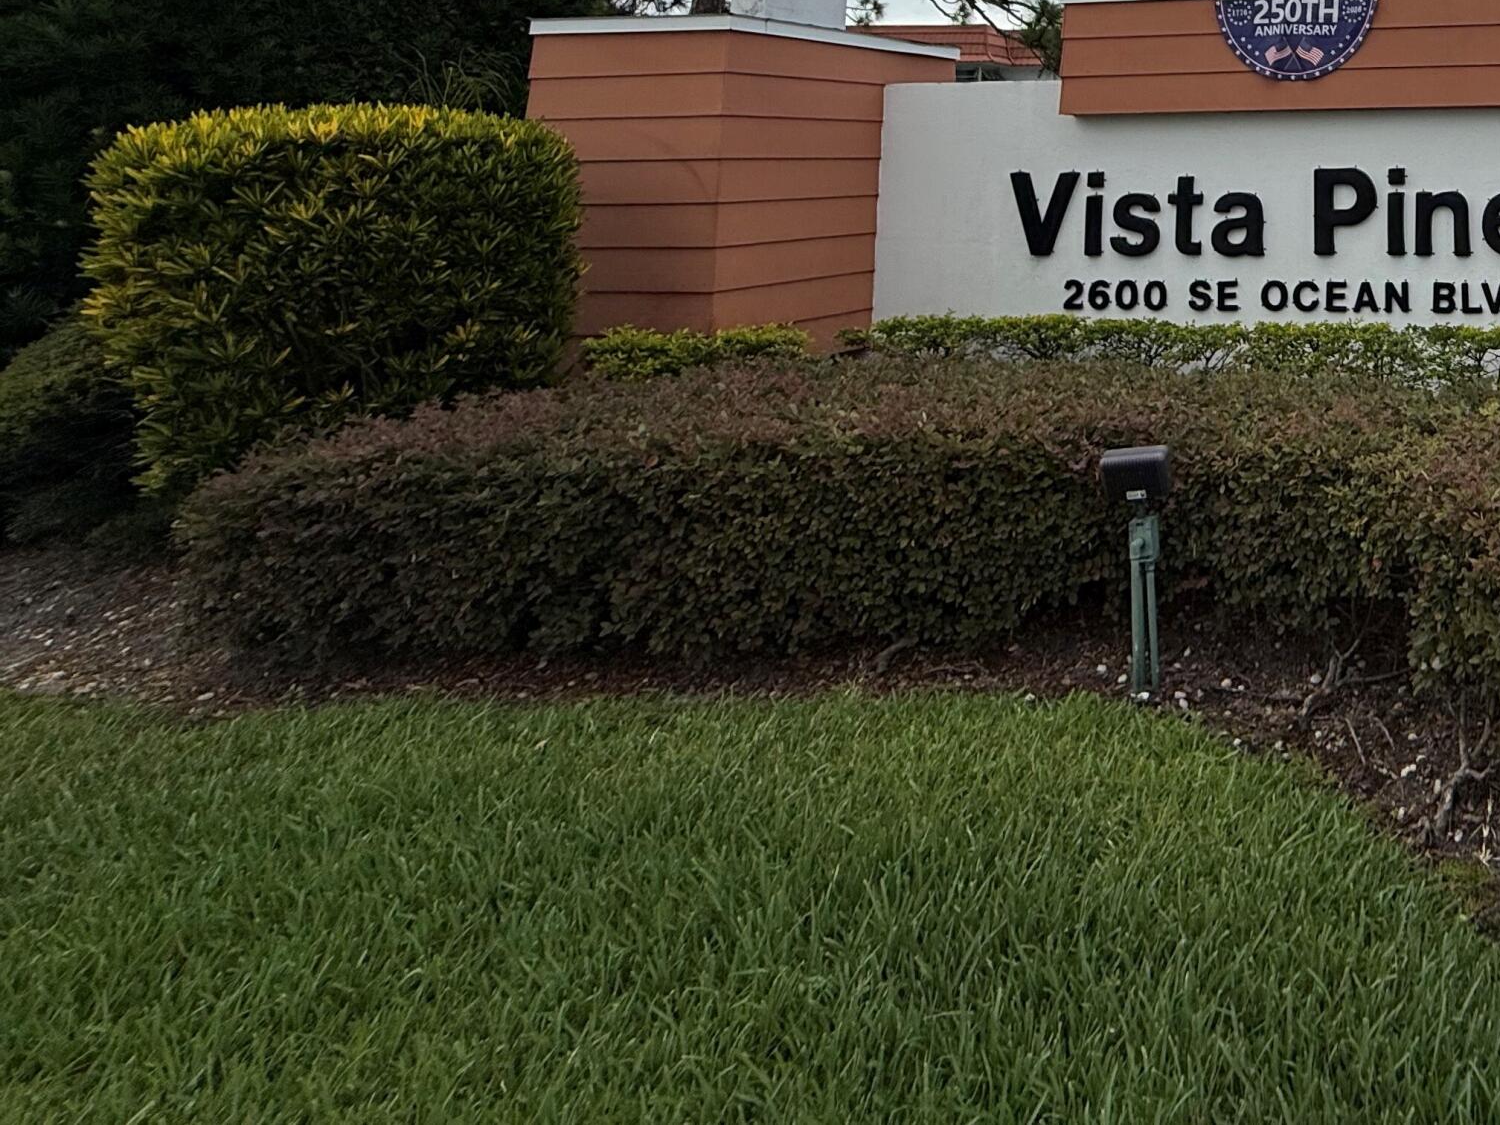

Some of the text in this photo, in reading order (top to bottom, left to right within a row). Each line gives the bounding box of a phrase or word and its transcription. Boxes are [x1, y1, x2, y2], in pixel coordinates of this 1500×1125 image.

[1254, 24, 1338, 37] ANNIVERSARY
[1010, 171, 1265, 258] Vista
[1063, 280, 1167, 311] 2600
[1189, 278, 1240, 312] SE
[1261, 281, 1411, 313] OCEAN
